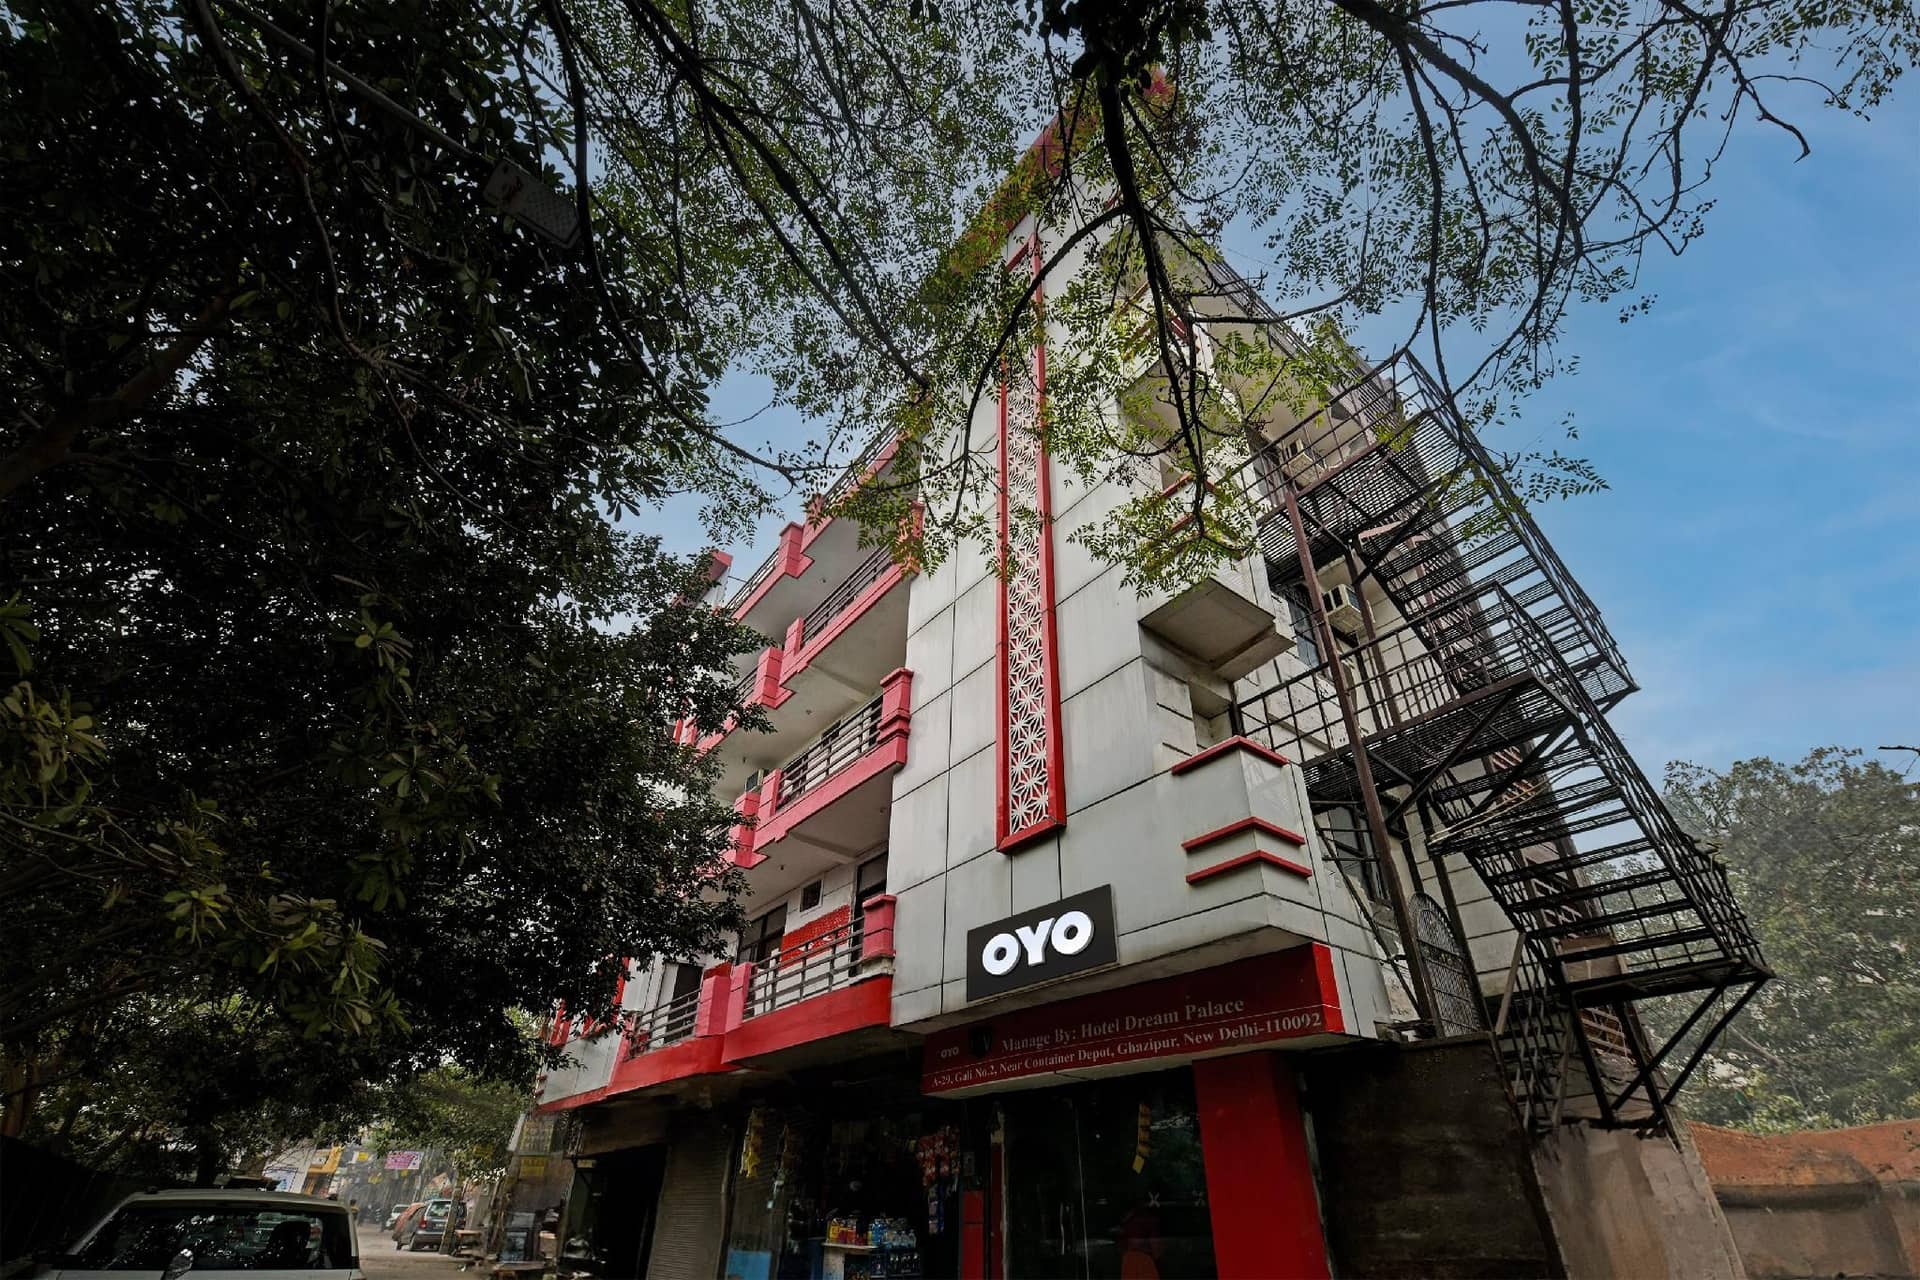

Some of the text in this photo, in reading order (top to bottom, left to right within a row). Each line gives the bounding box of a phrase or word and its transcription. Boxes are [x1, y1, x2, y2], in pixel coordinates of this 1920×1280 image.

[982, 910, 1094, 976] OYO
[940, 1046, 960, 1059] OYO
[955, 1069, 973, 1083] Gali
[975, 1065, 998, 1080] No.2,
[999, 1060, 1023, 1073] Near
[1024, 1053, 1076, 1070] Container
[1078, 1047, 1115, 1062] Depot,
[1184, 1030, 1215, 1046] New
[1220, 1013, 1321, 1040] Delhi-110092
[1002, 1034, 1050, 1052] Manage
[1054, 1028, 1077, 1047] By:
[1082, 1018, 1120, 1038] Hotel
[1125, 1011, 1178, 1031] Dream
[1185, 999, 1245, 1021] Palace
